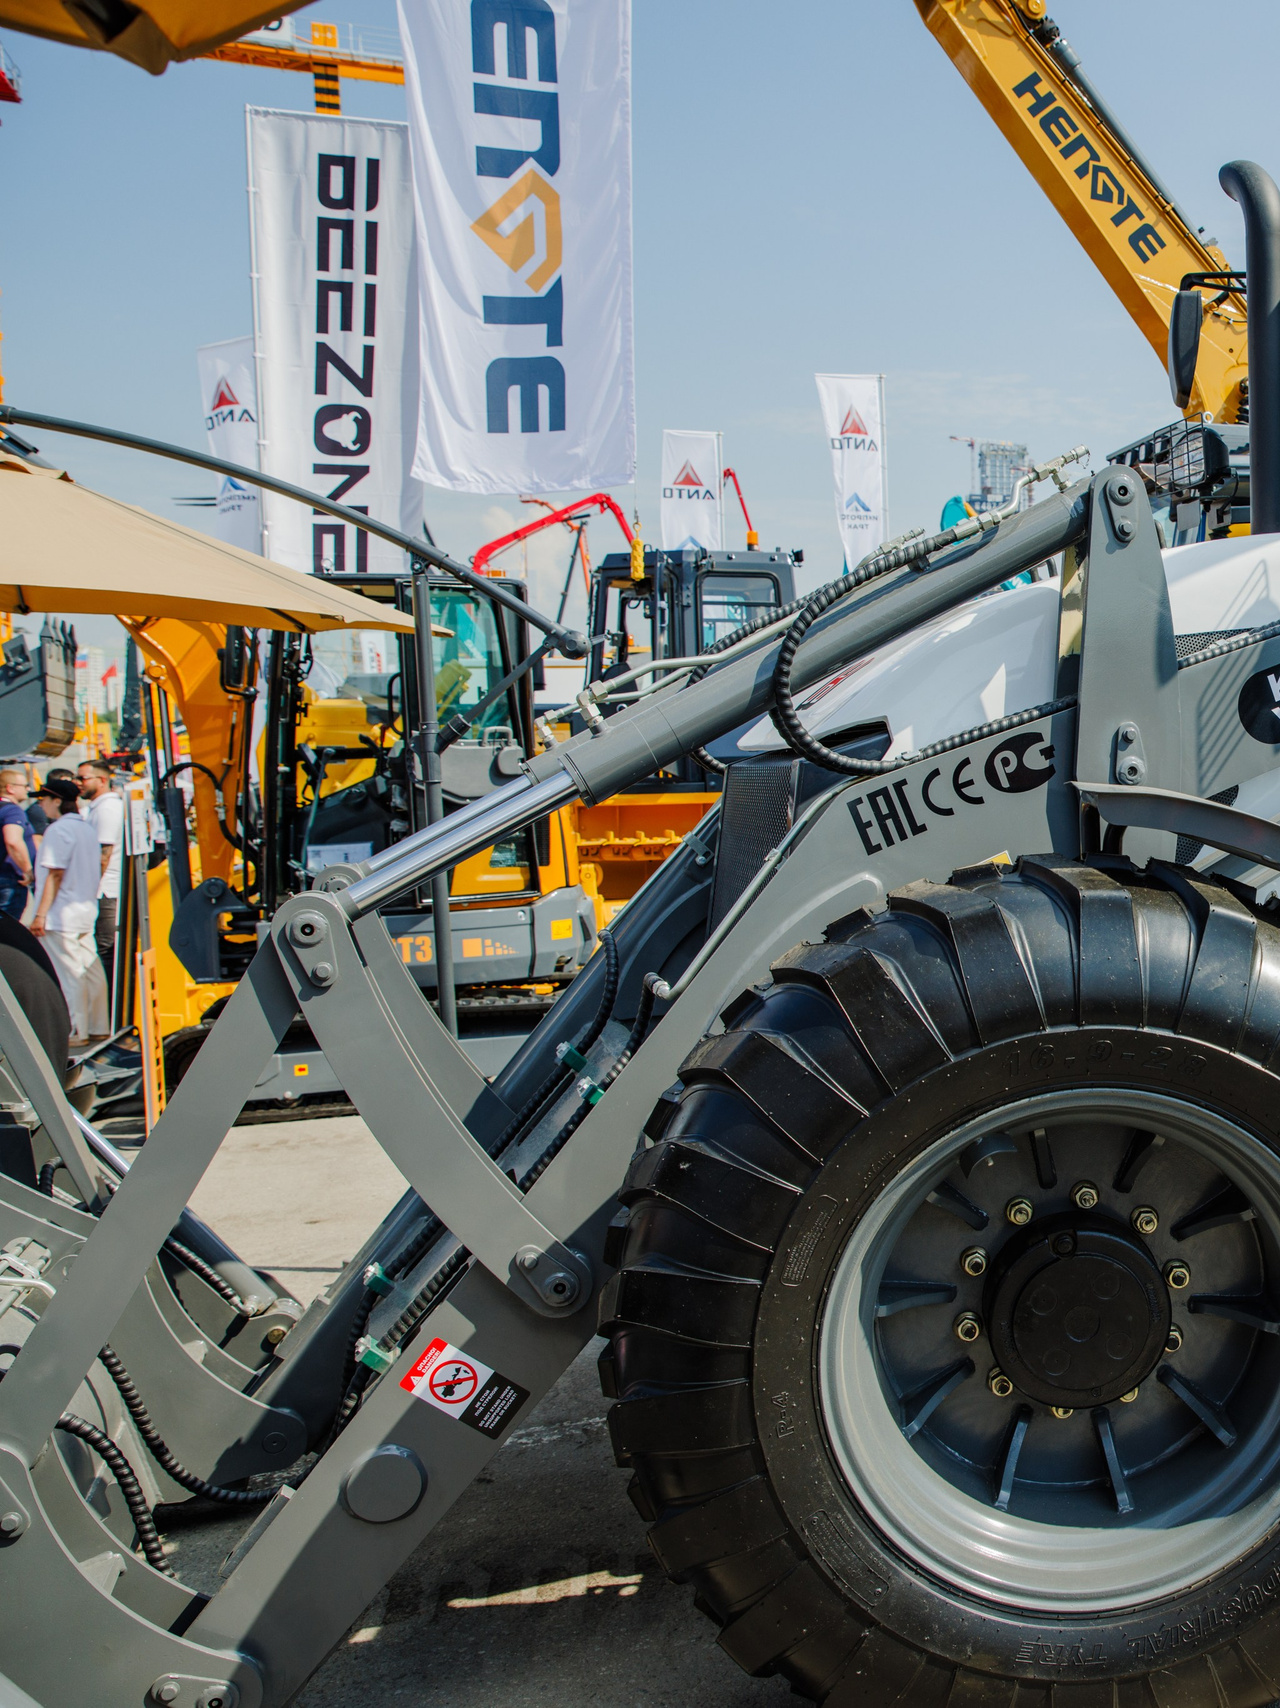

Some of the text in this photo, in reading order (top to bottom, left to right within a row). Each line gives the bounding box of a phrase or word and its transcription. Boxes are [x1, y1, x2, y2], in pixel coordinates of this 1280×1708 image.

[1012, 71, 1167, 264] HENGTE
[392, 936, 432, 963] T3
[416, 1347, 437, 1371] ОПАСНО!
[421, 1350, 441, 1373] DANGER!
[483, 1411, 492, 1421] NOT
[489, 1398, 502, 1413] STAND
[499, 1385, 512, 1400] UNDER
[504, 1389, 515, 1401] LOAD
[489, 1415, 501, 1429] FRAME
[770, 1391, 795, 1439] R-4
[1014, 1639, 1108, 1666] TYRE
